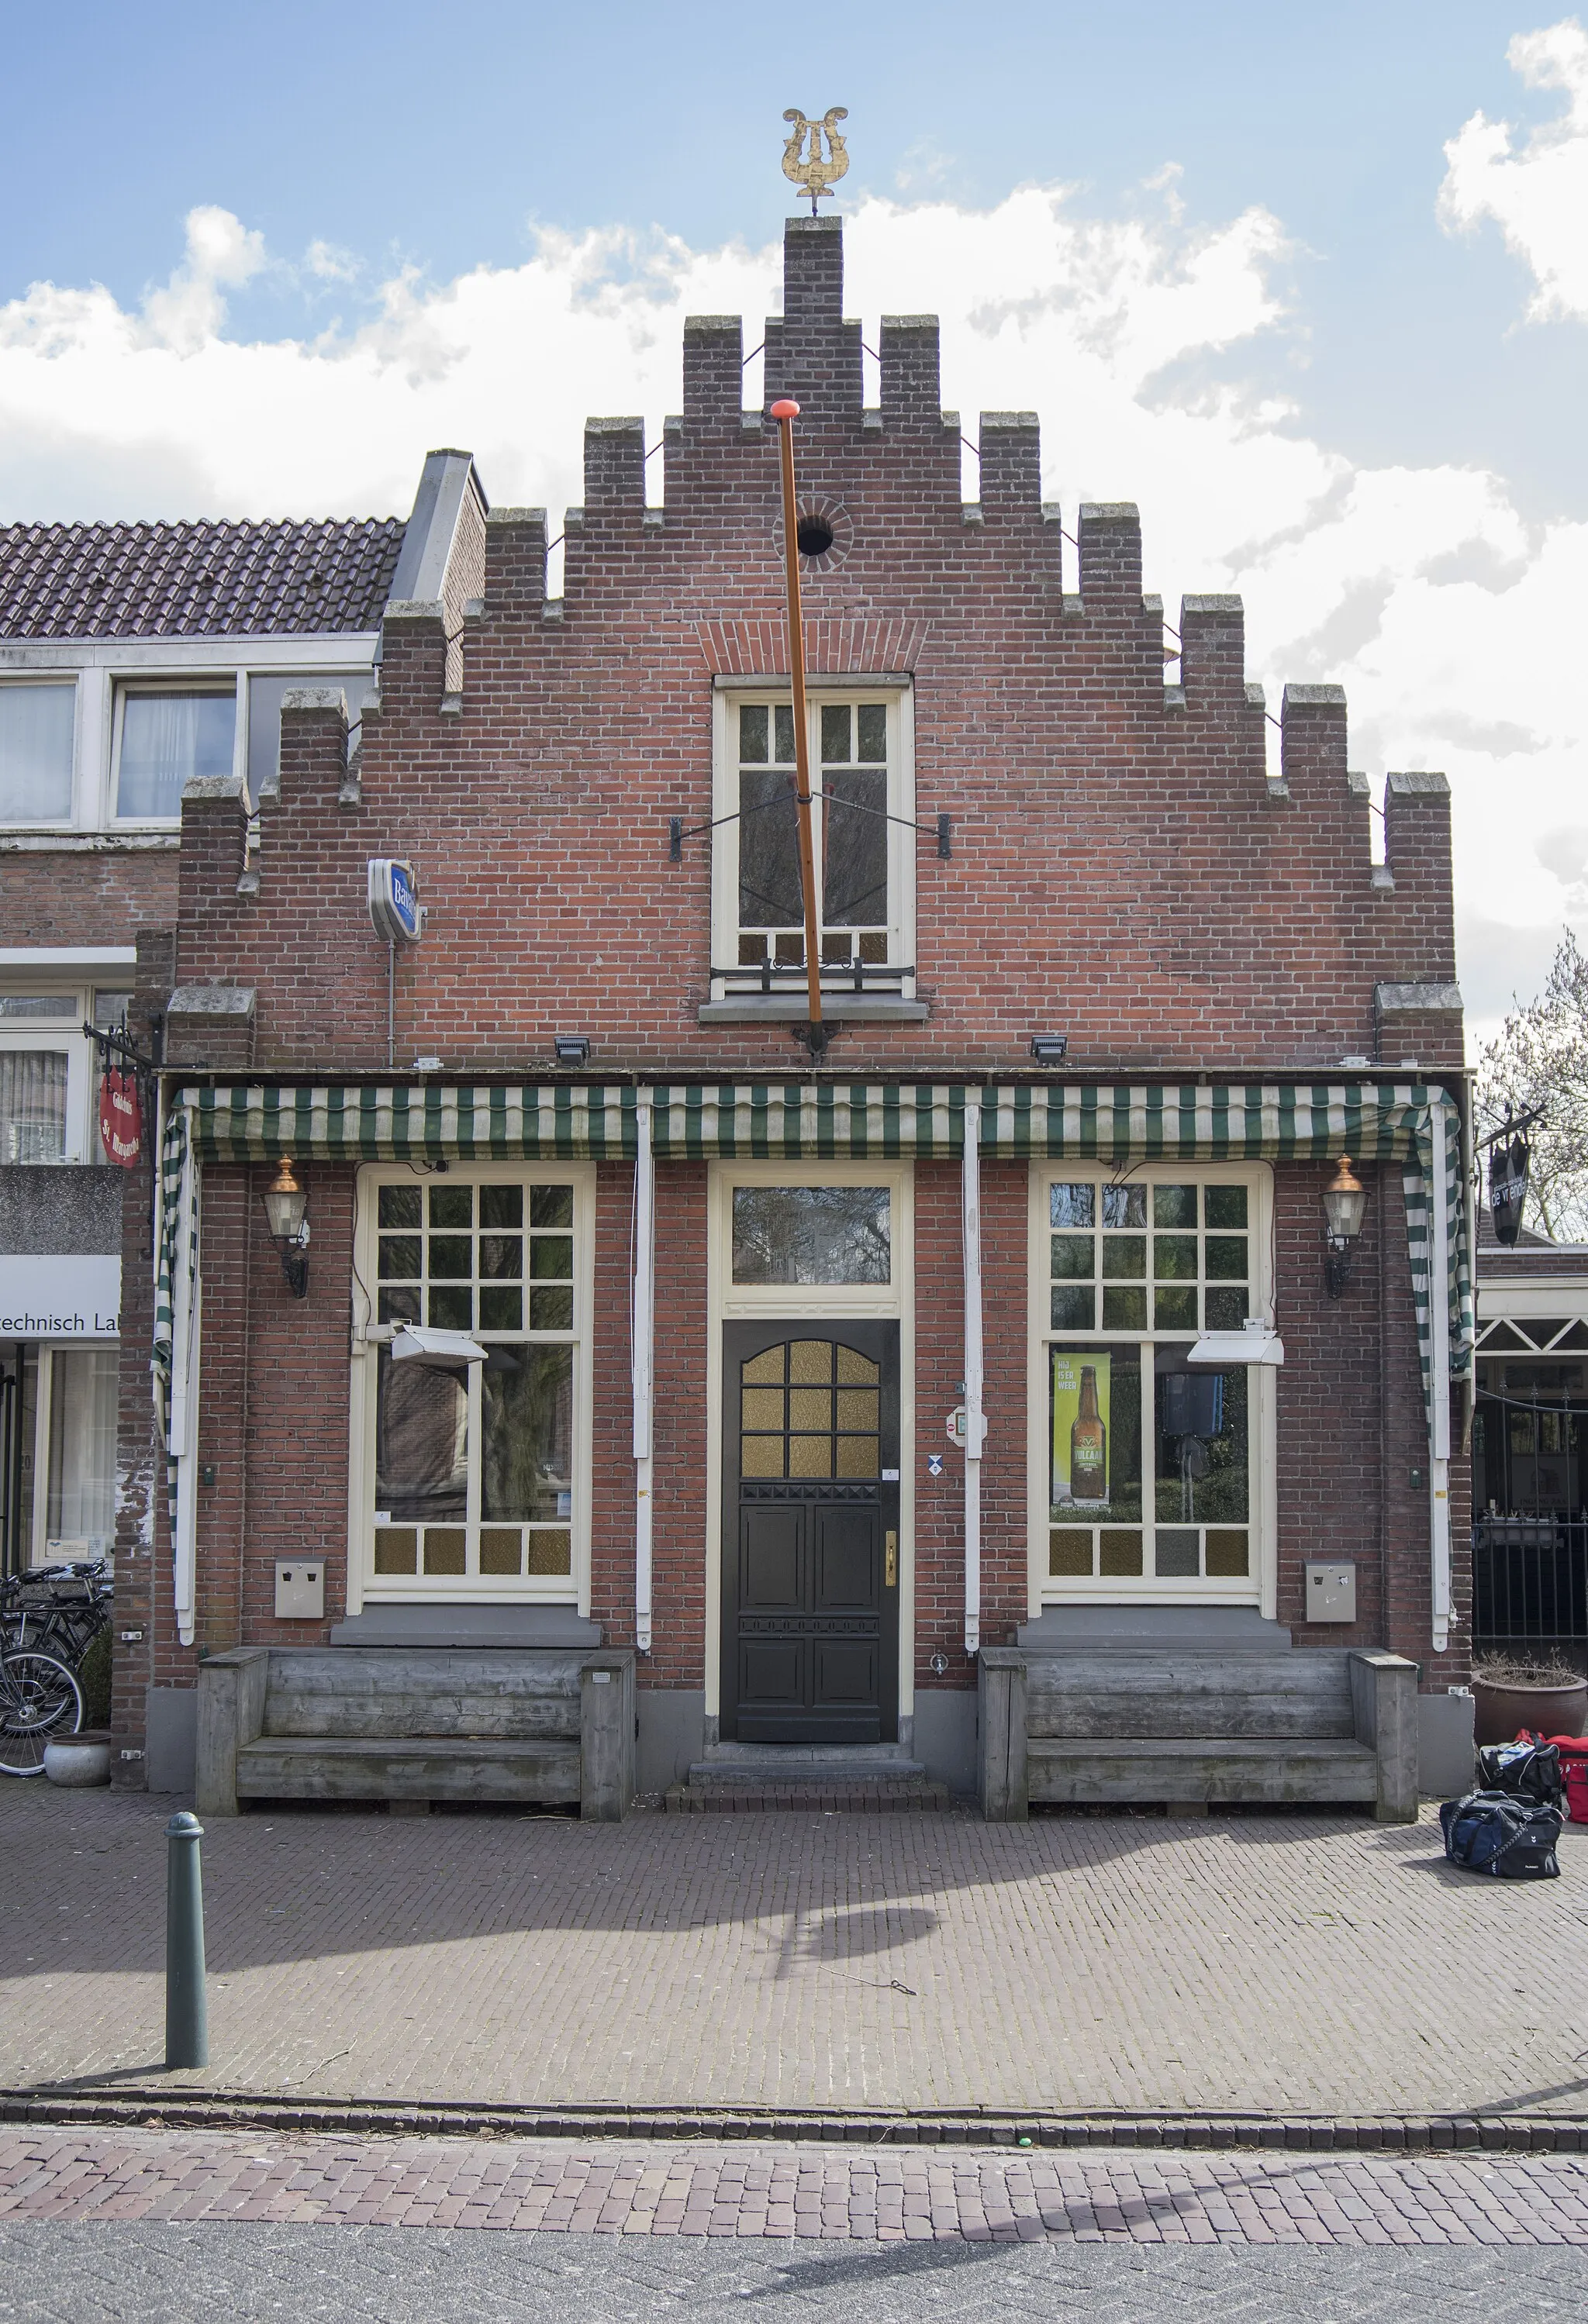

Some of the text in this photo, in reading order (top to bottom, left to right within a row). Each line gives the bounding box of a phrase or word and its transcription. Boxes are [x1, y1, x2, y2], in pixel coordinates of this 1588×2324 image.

[1491, 1187, 1500, 1207] de
[1058, 1371, 1074, 1380] IS ER
[1058, 1381, 1077, 1390] WEER
